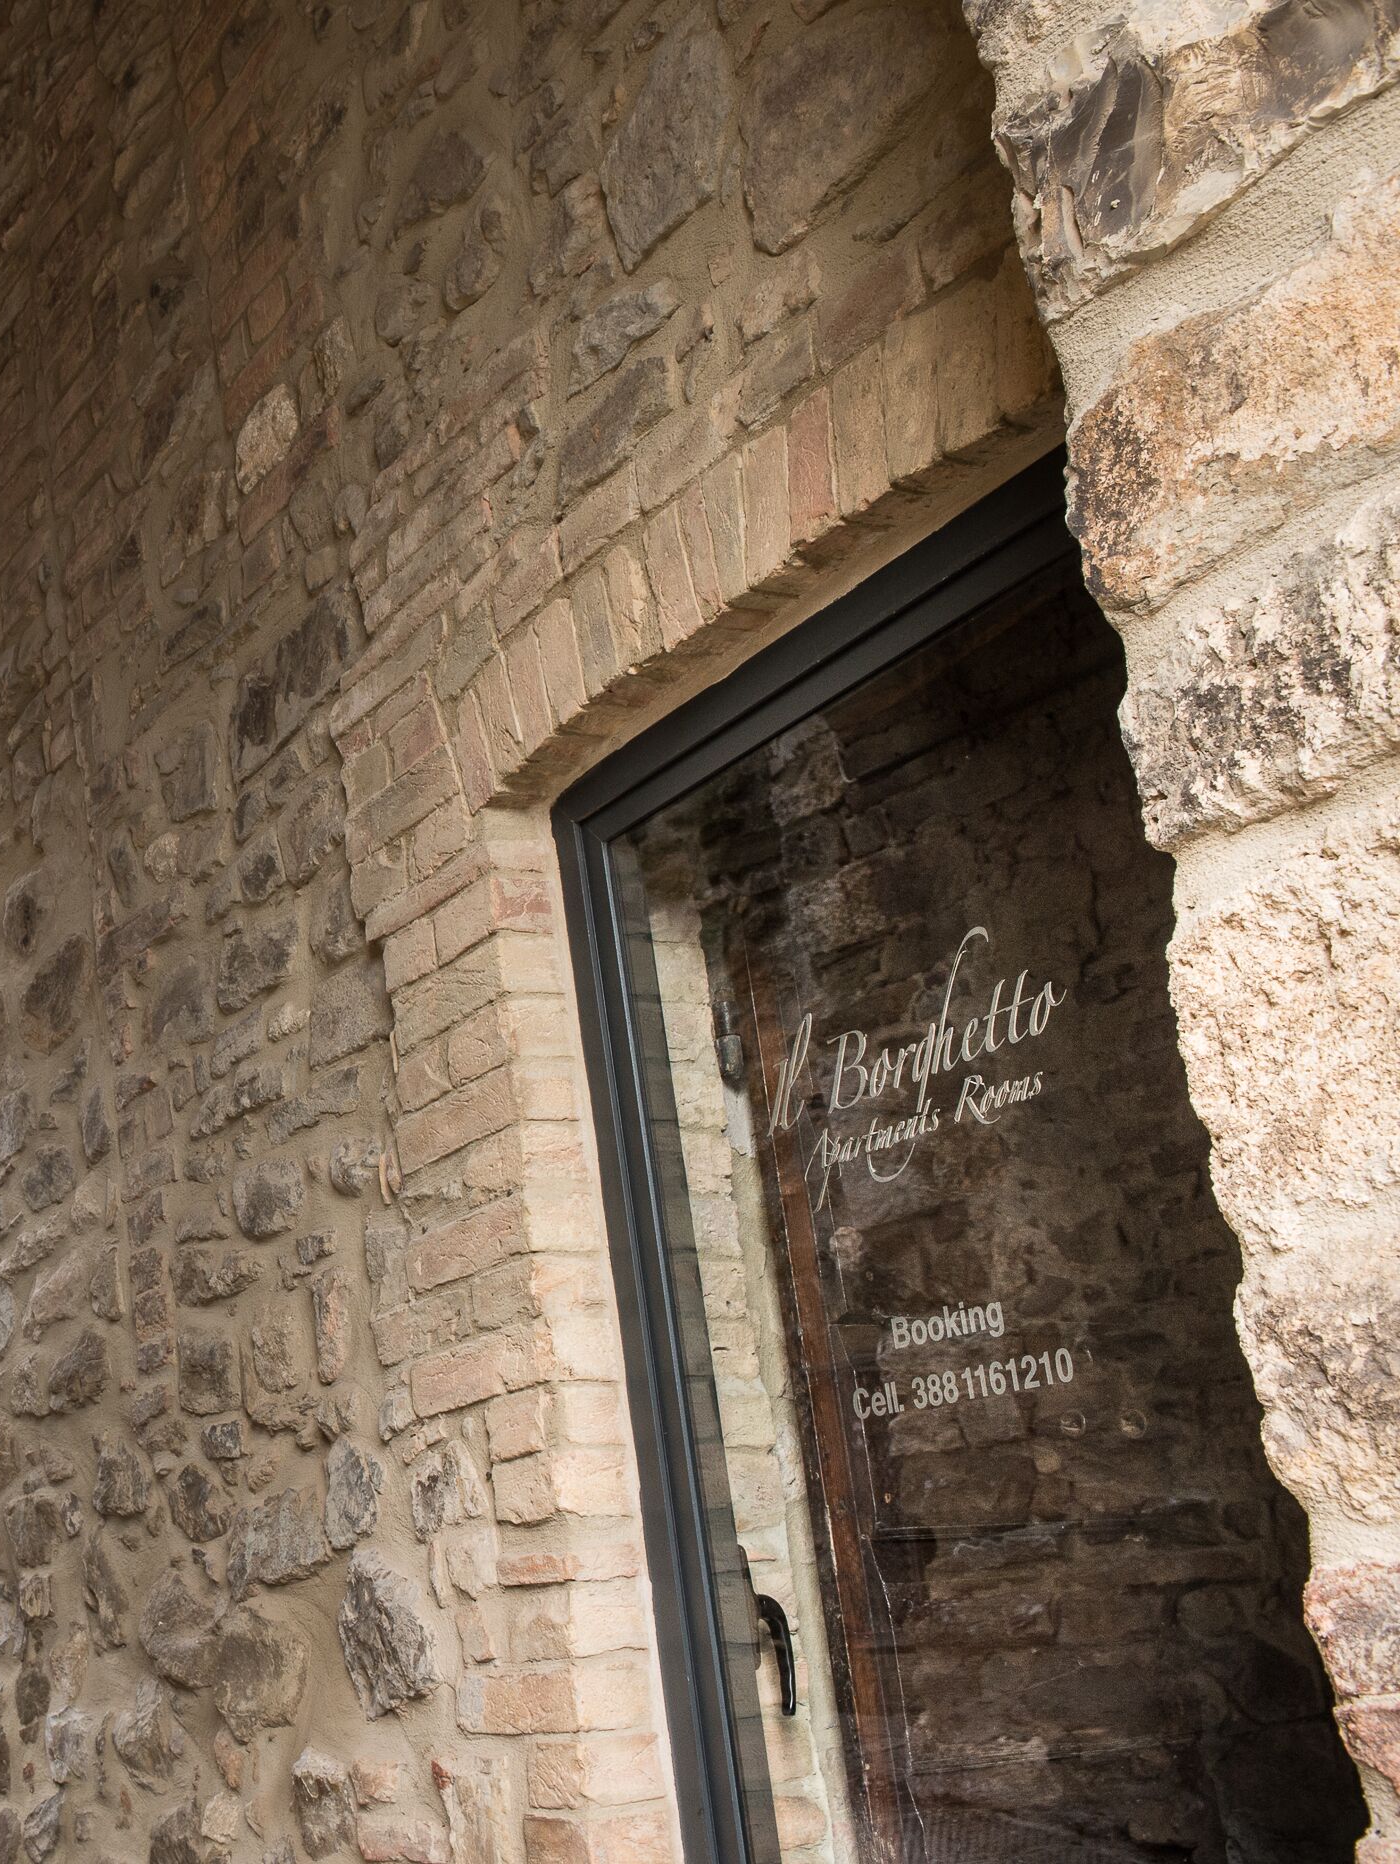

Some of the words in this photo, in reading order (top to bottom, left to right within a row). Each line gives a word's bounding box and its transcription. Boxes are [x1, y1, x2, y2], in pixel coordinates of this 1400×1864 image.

[768, 1012, 813, 1138] Il
[826, 926, 1068, 1114] Borghetto
[803, 1097, 941, 1215] Apartments
[953, 1071, 1044, 1135] Rooms
[890, 1301, 1005, 1350] Booking
[852, 1381, 905, 1420] Cell.
